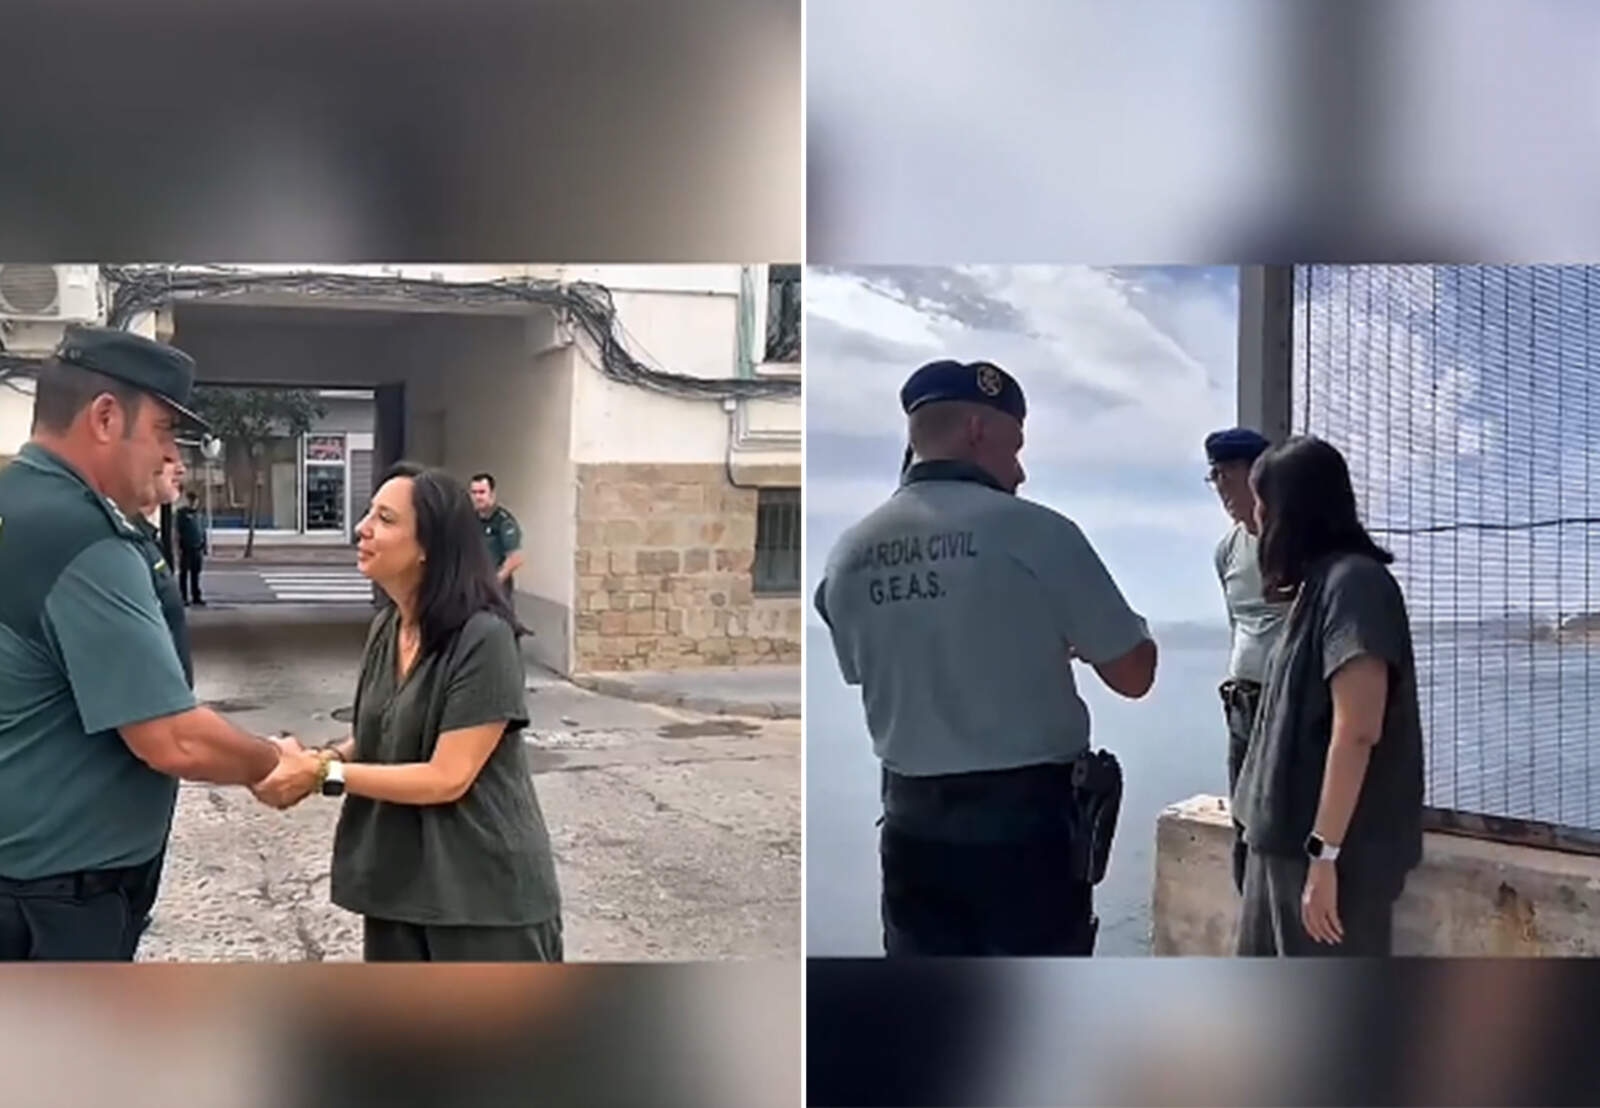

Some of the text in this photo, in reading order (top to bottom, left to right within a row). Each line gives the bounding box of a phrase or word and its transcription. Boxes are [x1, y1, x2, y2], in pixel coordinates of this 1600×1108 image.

[849, 531, 979, 571] ARDIA CIVIL
[869, 571, 947, 605] G.E.A.S.
